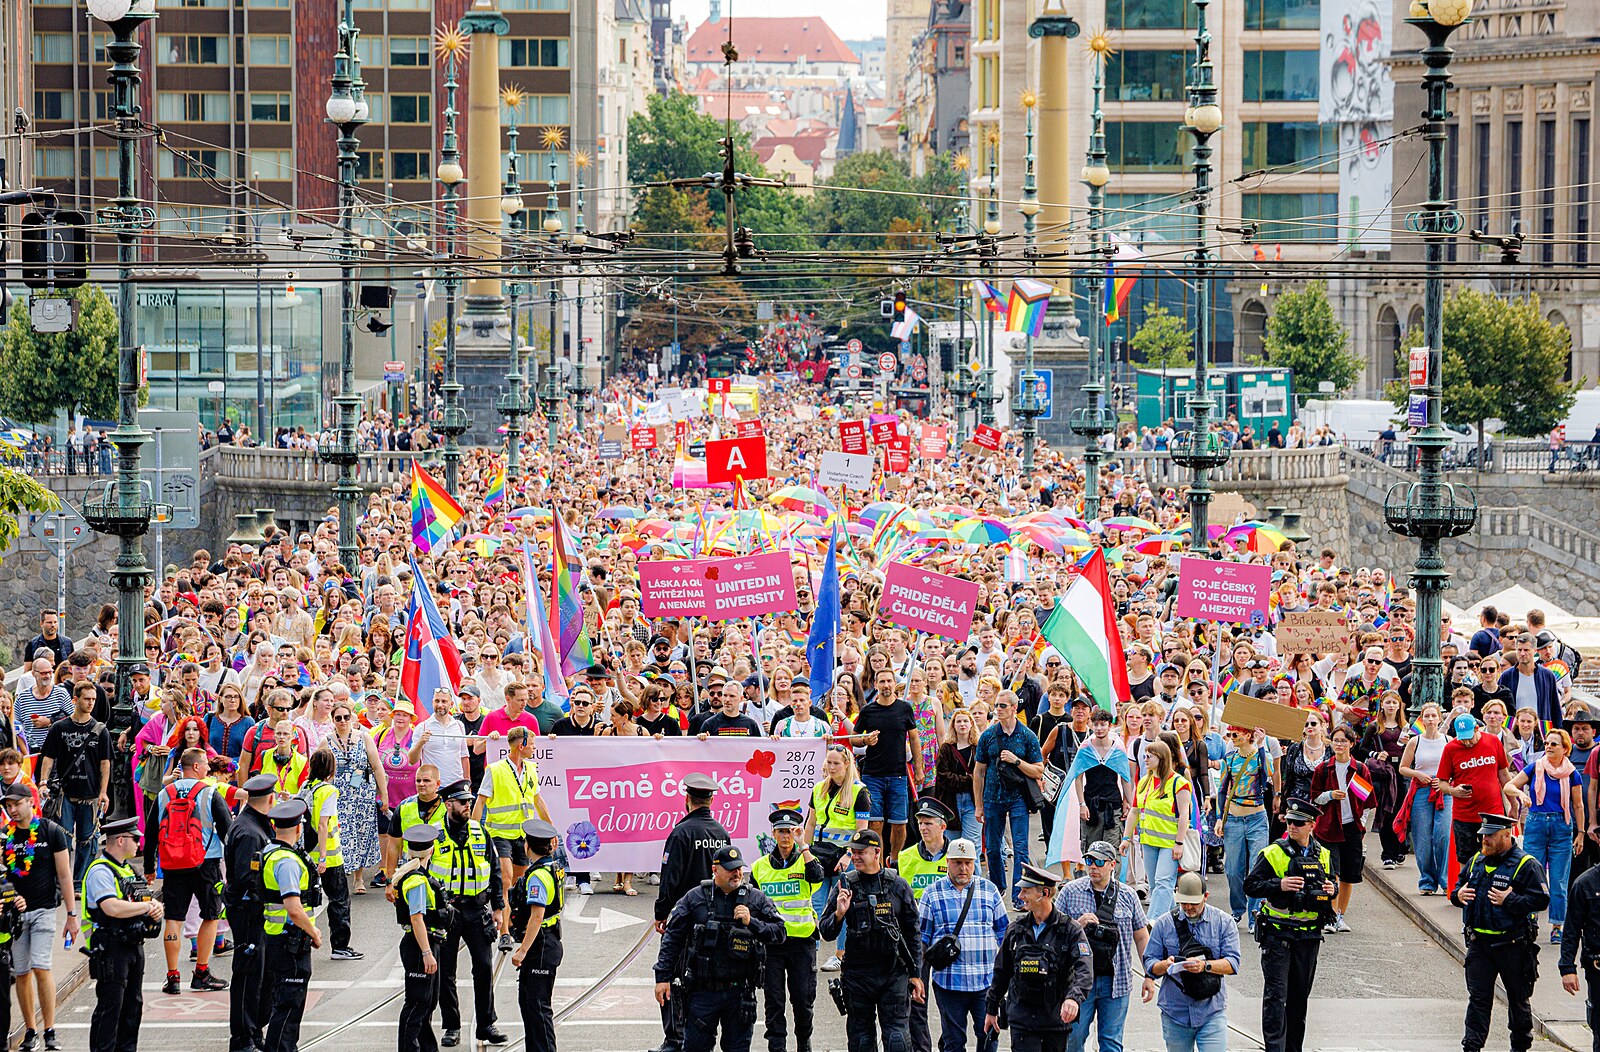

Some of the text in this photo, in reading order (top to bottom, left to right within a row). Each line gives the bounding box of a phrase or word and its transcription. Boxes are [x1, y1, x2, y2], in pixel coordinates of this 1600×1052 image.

[715, 381, 723, 391] B
[726, 446, 747, 471] A
[845, 458, 850, 467] 1
[648, 578, 702, 588] LÁSKA A QU
[715, 574, 781, 594] UNITED IN
[1192, 579, 1257, 595] CO JE ČESKÝ,
[649, 589, 686, 599] ZVÍTĚZÍ
[715, 590, 785, 610] DIVERSITY
[889, 584, 967, 615] PRIDE DĚLÁ
[1193, 590, 1255, 605] TO JE QUEER
[659, 599, 706, 609] A NENÁVIS
[1200, 603, 1246, 616] A HEZKÝ!
[891, 600, 959, 629] ČLOVĚKA.
[1293, 628, 1316, 638] Bros
[1321, 640, 1342, 653] HOES
[786, 751, 815, 761] 28/7
[1460, 756, 1495, 769] adidas
[574, 770, 754, 800] Země čeká,
[783, 778, 815, 788] 2025
[711, 802, 742, 833] ůj
[762, 882, 799, 895] POLICIE
